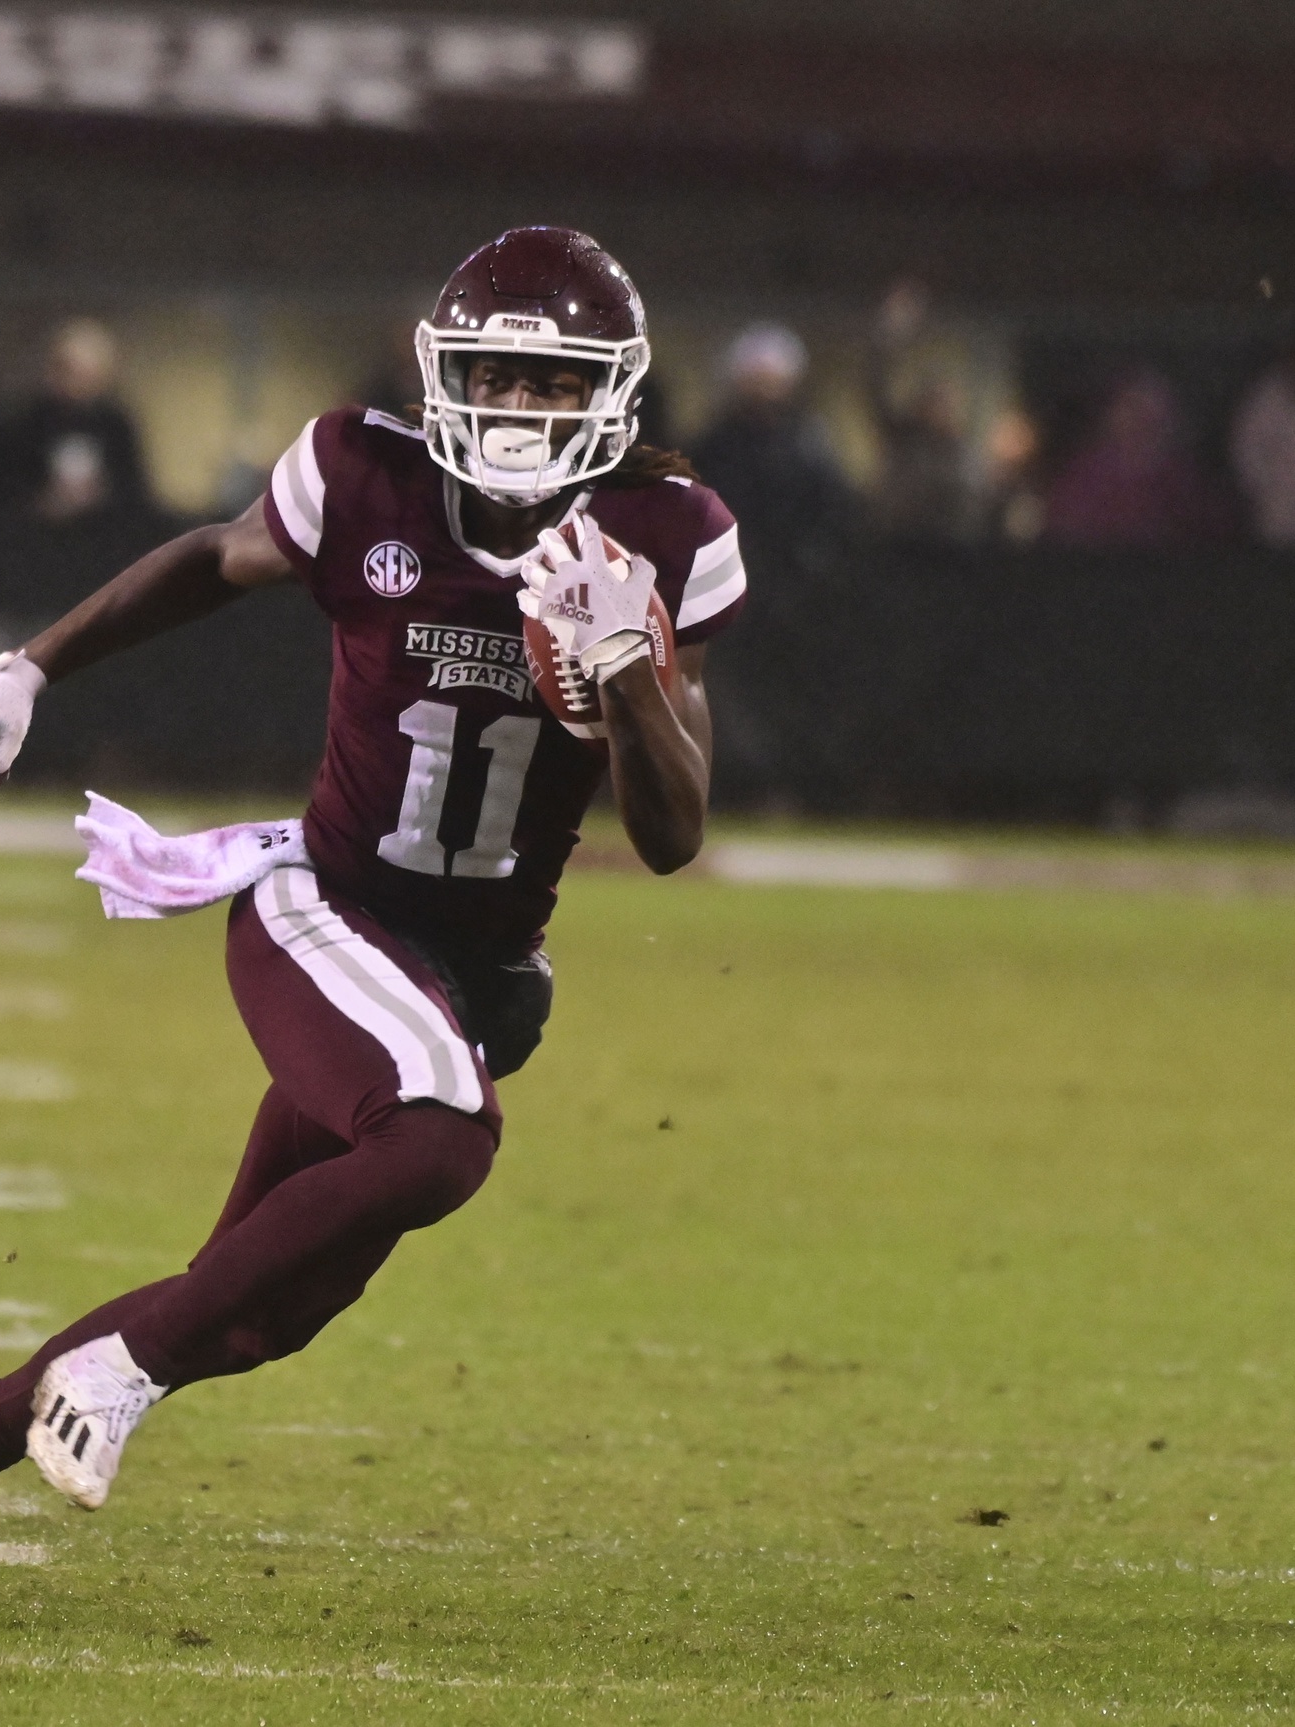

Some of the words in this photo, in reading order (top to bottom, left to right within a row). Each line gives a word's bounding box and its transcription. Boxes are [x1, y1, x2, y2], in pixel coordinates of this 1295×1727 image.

[501, 317, 541, 332] STATE
[368, 545, 415, 593] SEC
[545, 601, 596, 626] adidas
[447, 665, 520, 696] STATE
[376, 699, 542, 879] 11
